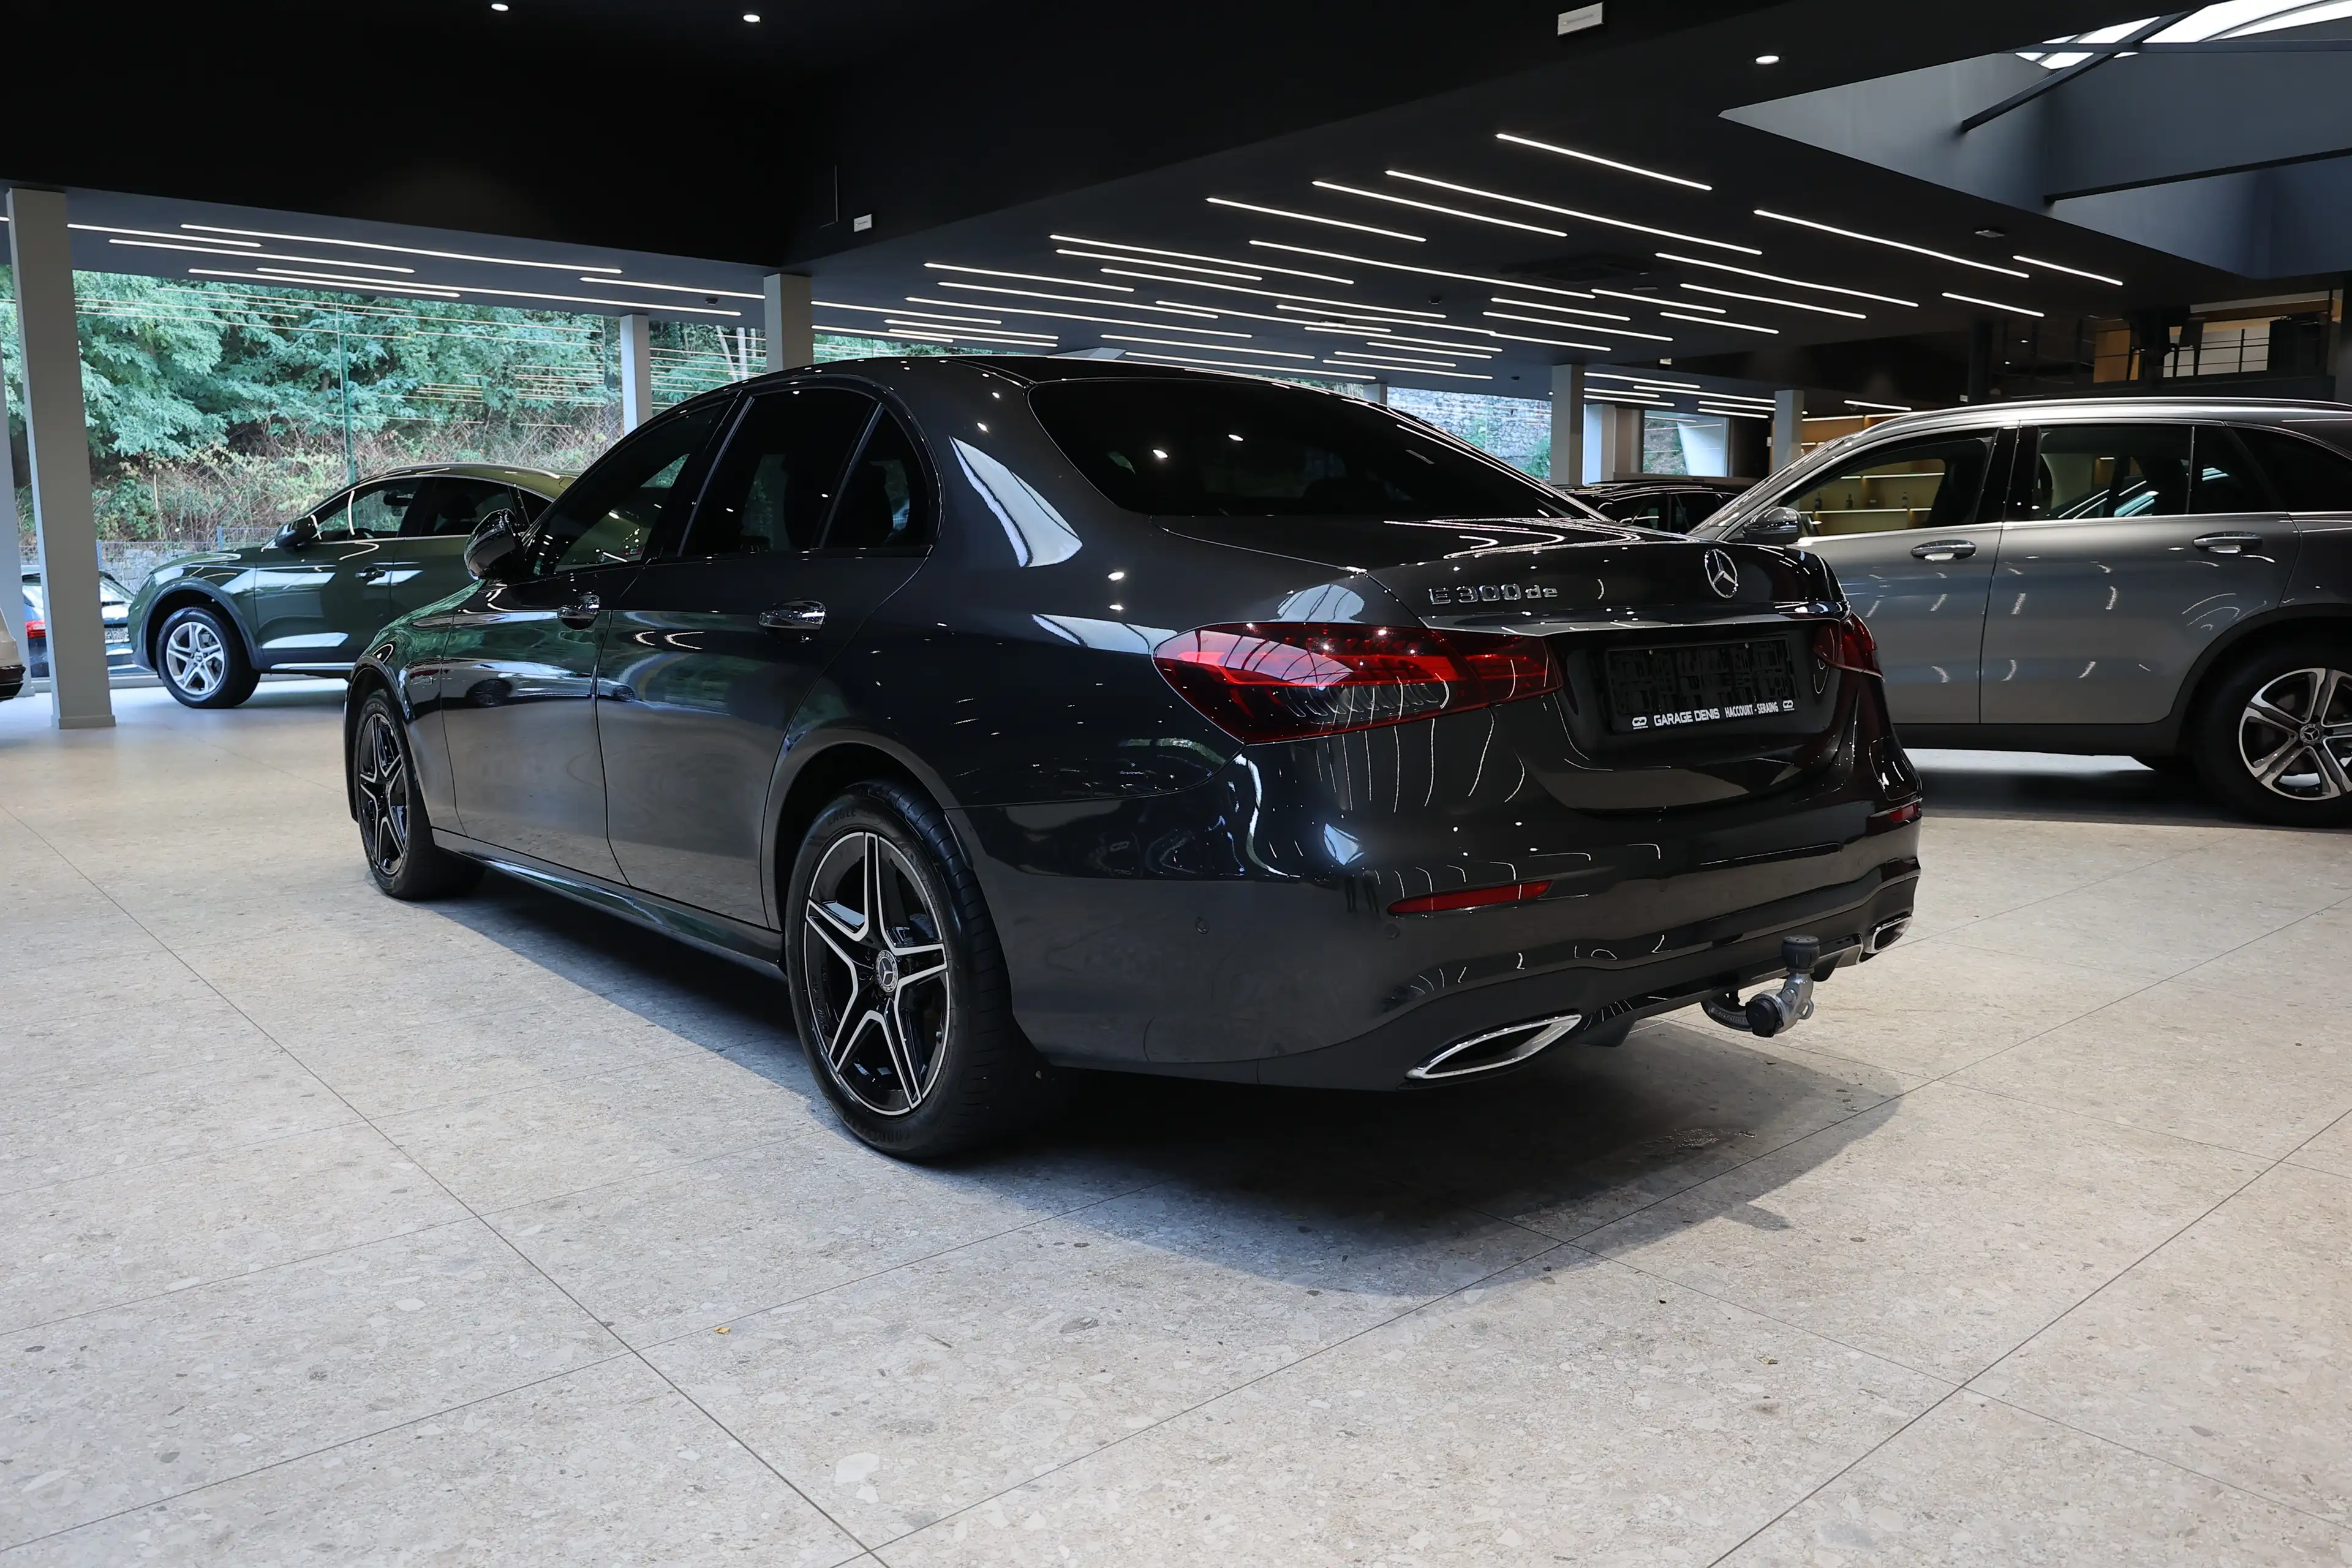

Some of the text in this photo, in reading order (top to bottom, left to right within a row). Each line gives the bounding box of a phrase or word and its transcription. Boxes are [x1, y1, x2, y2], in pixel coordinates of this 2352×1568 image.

[1428, 587, 1451, 605] E
[1653, 707, 1721, 726] GARAGE DENIS
[1724, 704, 1754, 718] HACCOURT
[1757, 701, 1779, 715] SERAING
